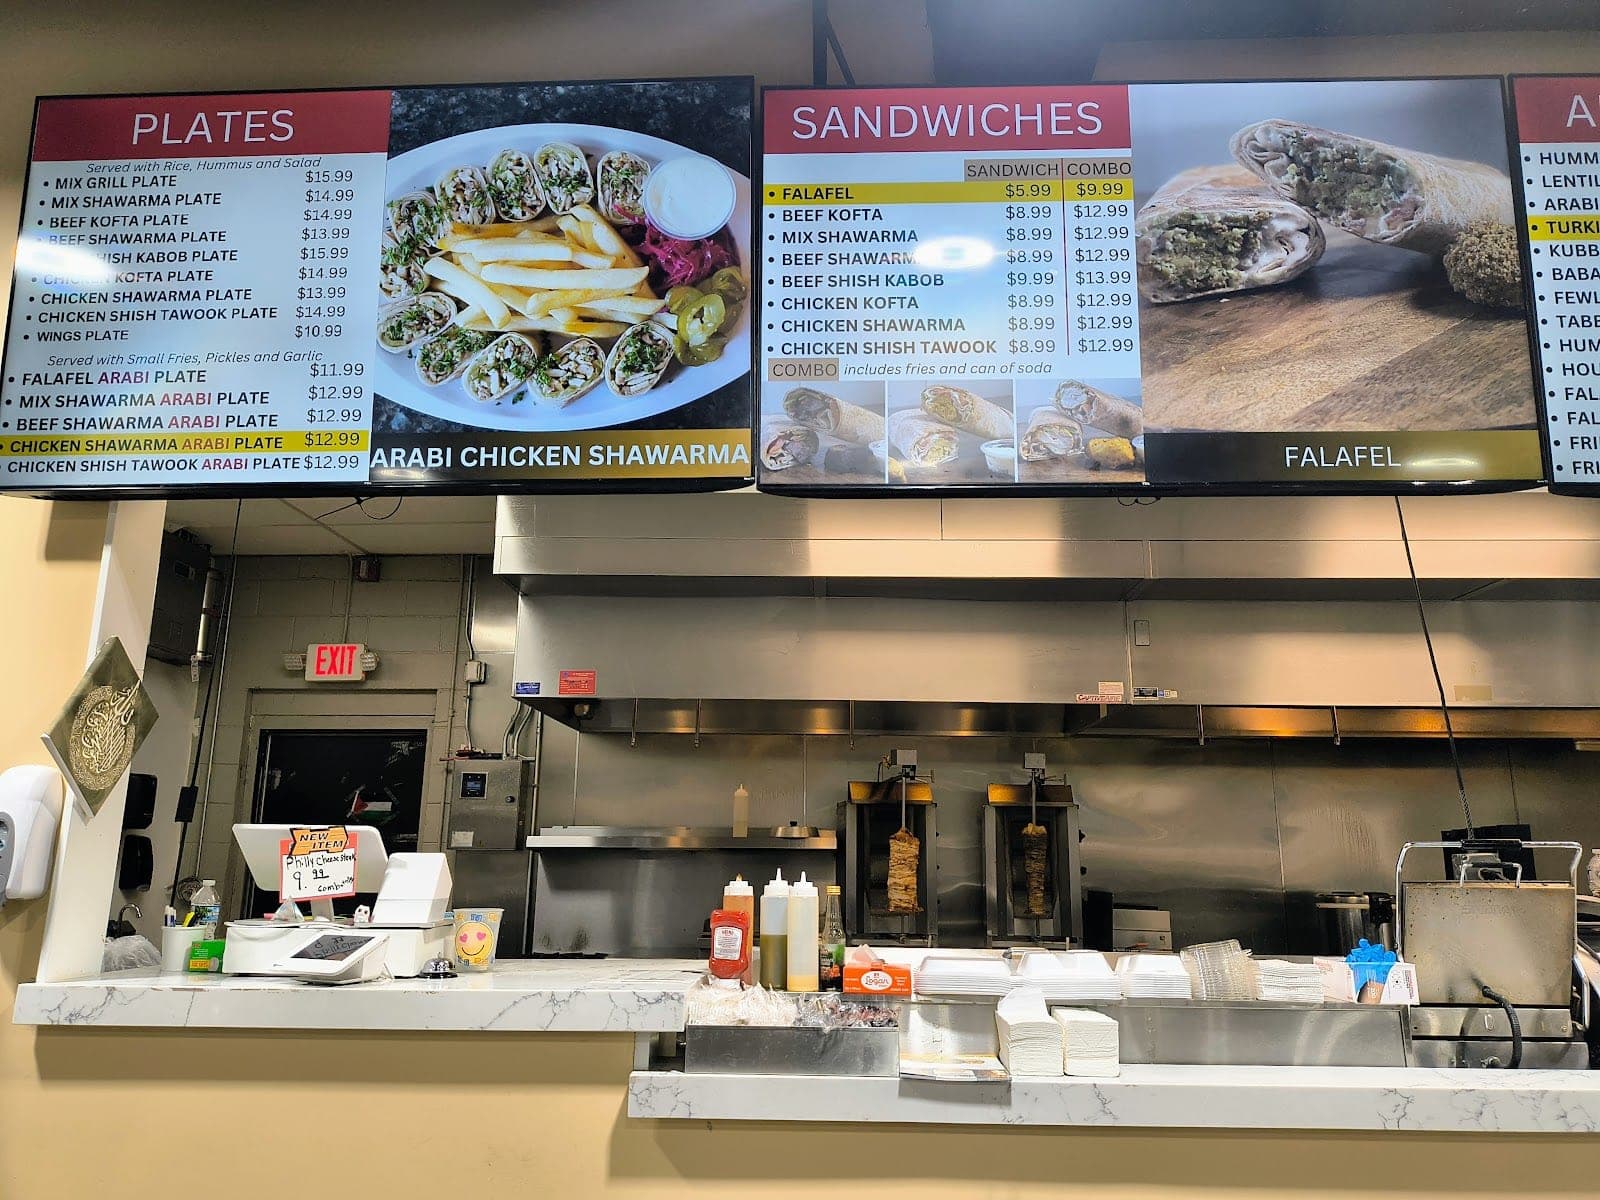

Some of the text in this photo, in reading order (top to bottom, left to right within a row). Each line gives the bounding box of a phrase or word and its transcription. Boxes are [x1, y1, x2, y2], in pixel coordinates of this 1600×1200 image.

[1566, 94, 1600, 128] A
[132, 110, 294, 145] PLATES
[792, 102, 1102, 139] SANDWICHES
[87, 157, 321, 173] Served with Rice, Hummus and Salad
[967, 162, 1132, 178] SANDWICH COMBO
[55, 170, 353, 189] MIX GRILL PLATE $15.99
[52, 189, 354, 209] MIX SHAWARMA PLATE $14.99
[782, 182, 1124, 201] FALAFEL $5.99 $9.99
[50, 209, 352, 228] BEEF KOFTA PLATE $14.99
[782, 204, 1128, 222] BEEF KOFTA $8.99 $12.99
[50, 228, 350, 246] BEEF SHAWARMA PLATE $13.99
[782, 226, 1129, 244] MIX SHAWARMA $8.99 $12.99
[91, 248, 348, 263] HISH KABOB PLATE $15.99
[782, 248, 1130, 266] BEEF SHAWARM $8.99 $12.99
[116, 272, 163, 283] KOFTA
[168, 270, 213, 282] PLATE
[298, 267, 348, 280] $14.99
[782, 270, 1131, 288] BEEF SHISH KABOB $9.99 $13.99
[41, 287, 346, 305] CHICKEN SHAWARMA PLATE $13.99
[781, 292, 1132, 310] CHICKEN KOFTA $8.99 $12.99
[38, 306, 346, 323] CHICKEN SHISH TAWOOK PLATE $14.99
[781, 315, 1133, 332] CHICKEN SHAWARMA $8.99 $12.99
[37, 325, 342, 342] WINGS PLATE $10.99
[781, 338, 1134, 355] CHICKEN SHISH TAWOOK $8.99 $12.99
[48, 349, 322, 366] Served with Small Fries, Pickles and Garlic
[22, 363, 364, 386] FALAFEL ARABI PLATE $11.99
[772, 361, 1052, 378] COMBO includes fries and can of soda
[19, 386, 363, 408] MIX SHAWARMA ARABI PLATE $12.99
[16, 409, 362, 431] BEEF SHAWARMA ARABI PLATE $12.99
[10, 432, 360, 452] CHICKEN SHAWARMA ARABI PLATE $12.99
[8, 455, 359, 473] CHICKEN SHISH TAWOOK ARABI PLATE $12.99
[370, 443, 749, 469] ARABI CHICKEN SHAWARMA
[1285, 446, 1401, 468] FALAFEL
[316, 646, 357, 675] EXIT
[300, 833, 328, 841] NEW
[313, 841, 343, 849] ITEM
[287, 856, 314, 870] Philly
